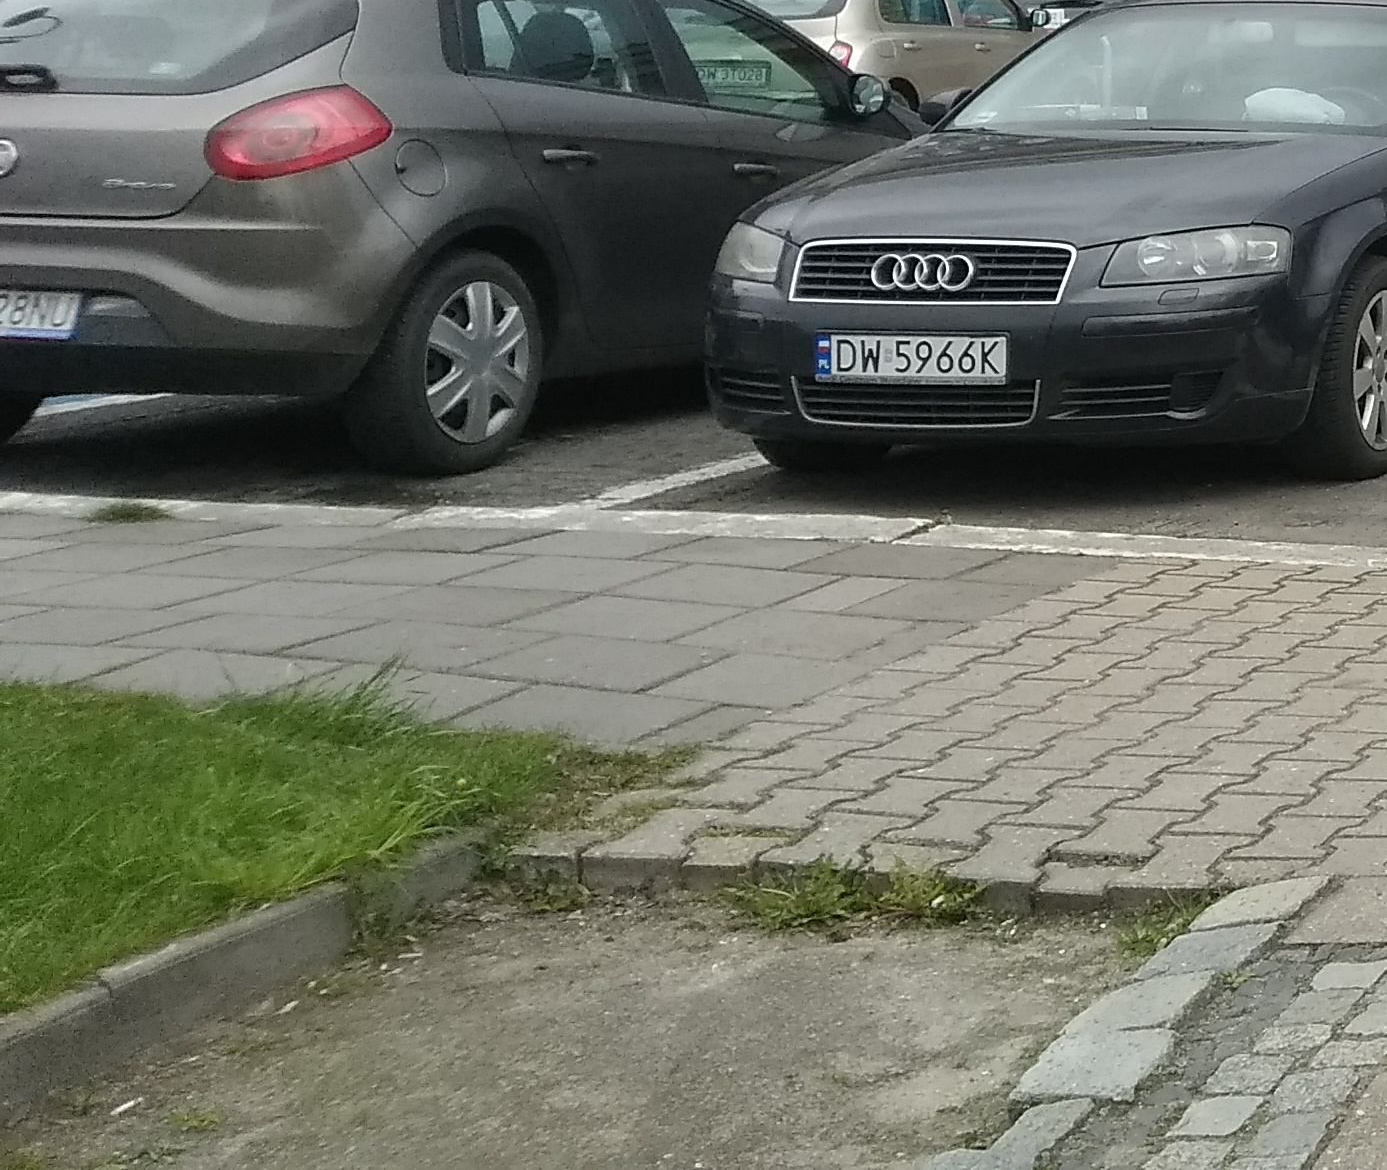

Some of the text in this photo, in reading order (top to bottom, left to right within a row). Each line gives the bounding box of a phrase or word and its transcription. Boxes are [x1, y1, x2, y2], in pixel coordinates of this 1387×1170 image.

[818, 359, 830, 369] PL
[836, 338, 1001, 375] DW 5966K
